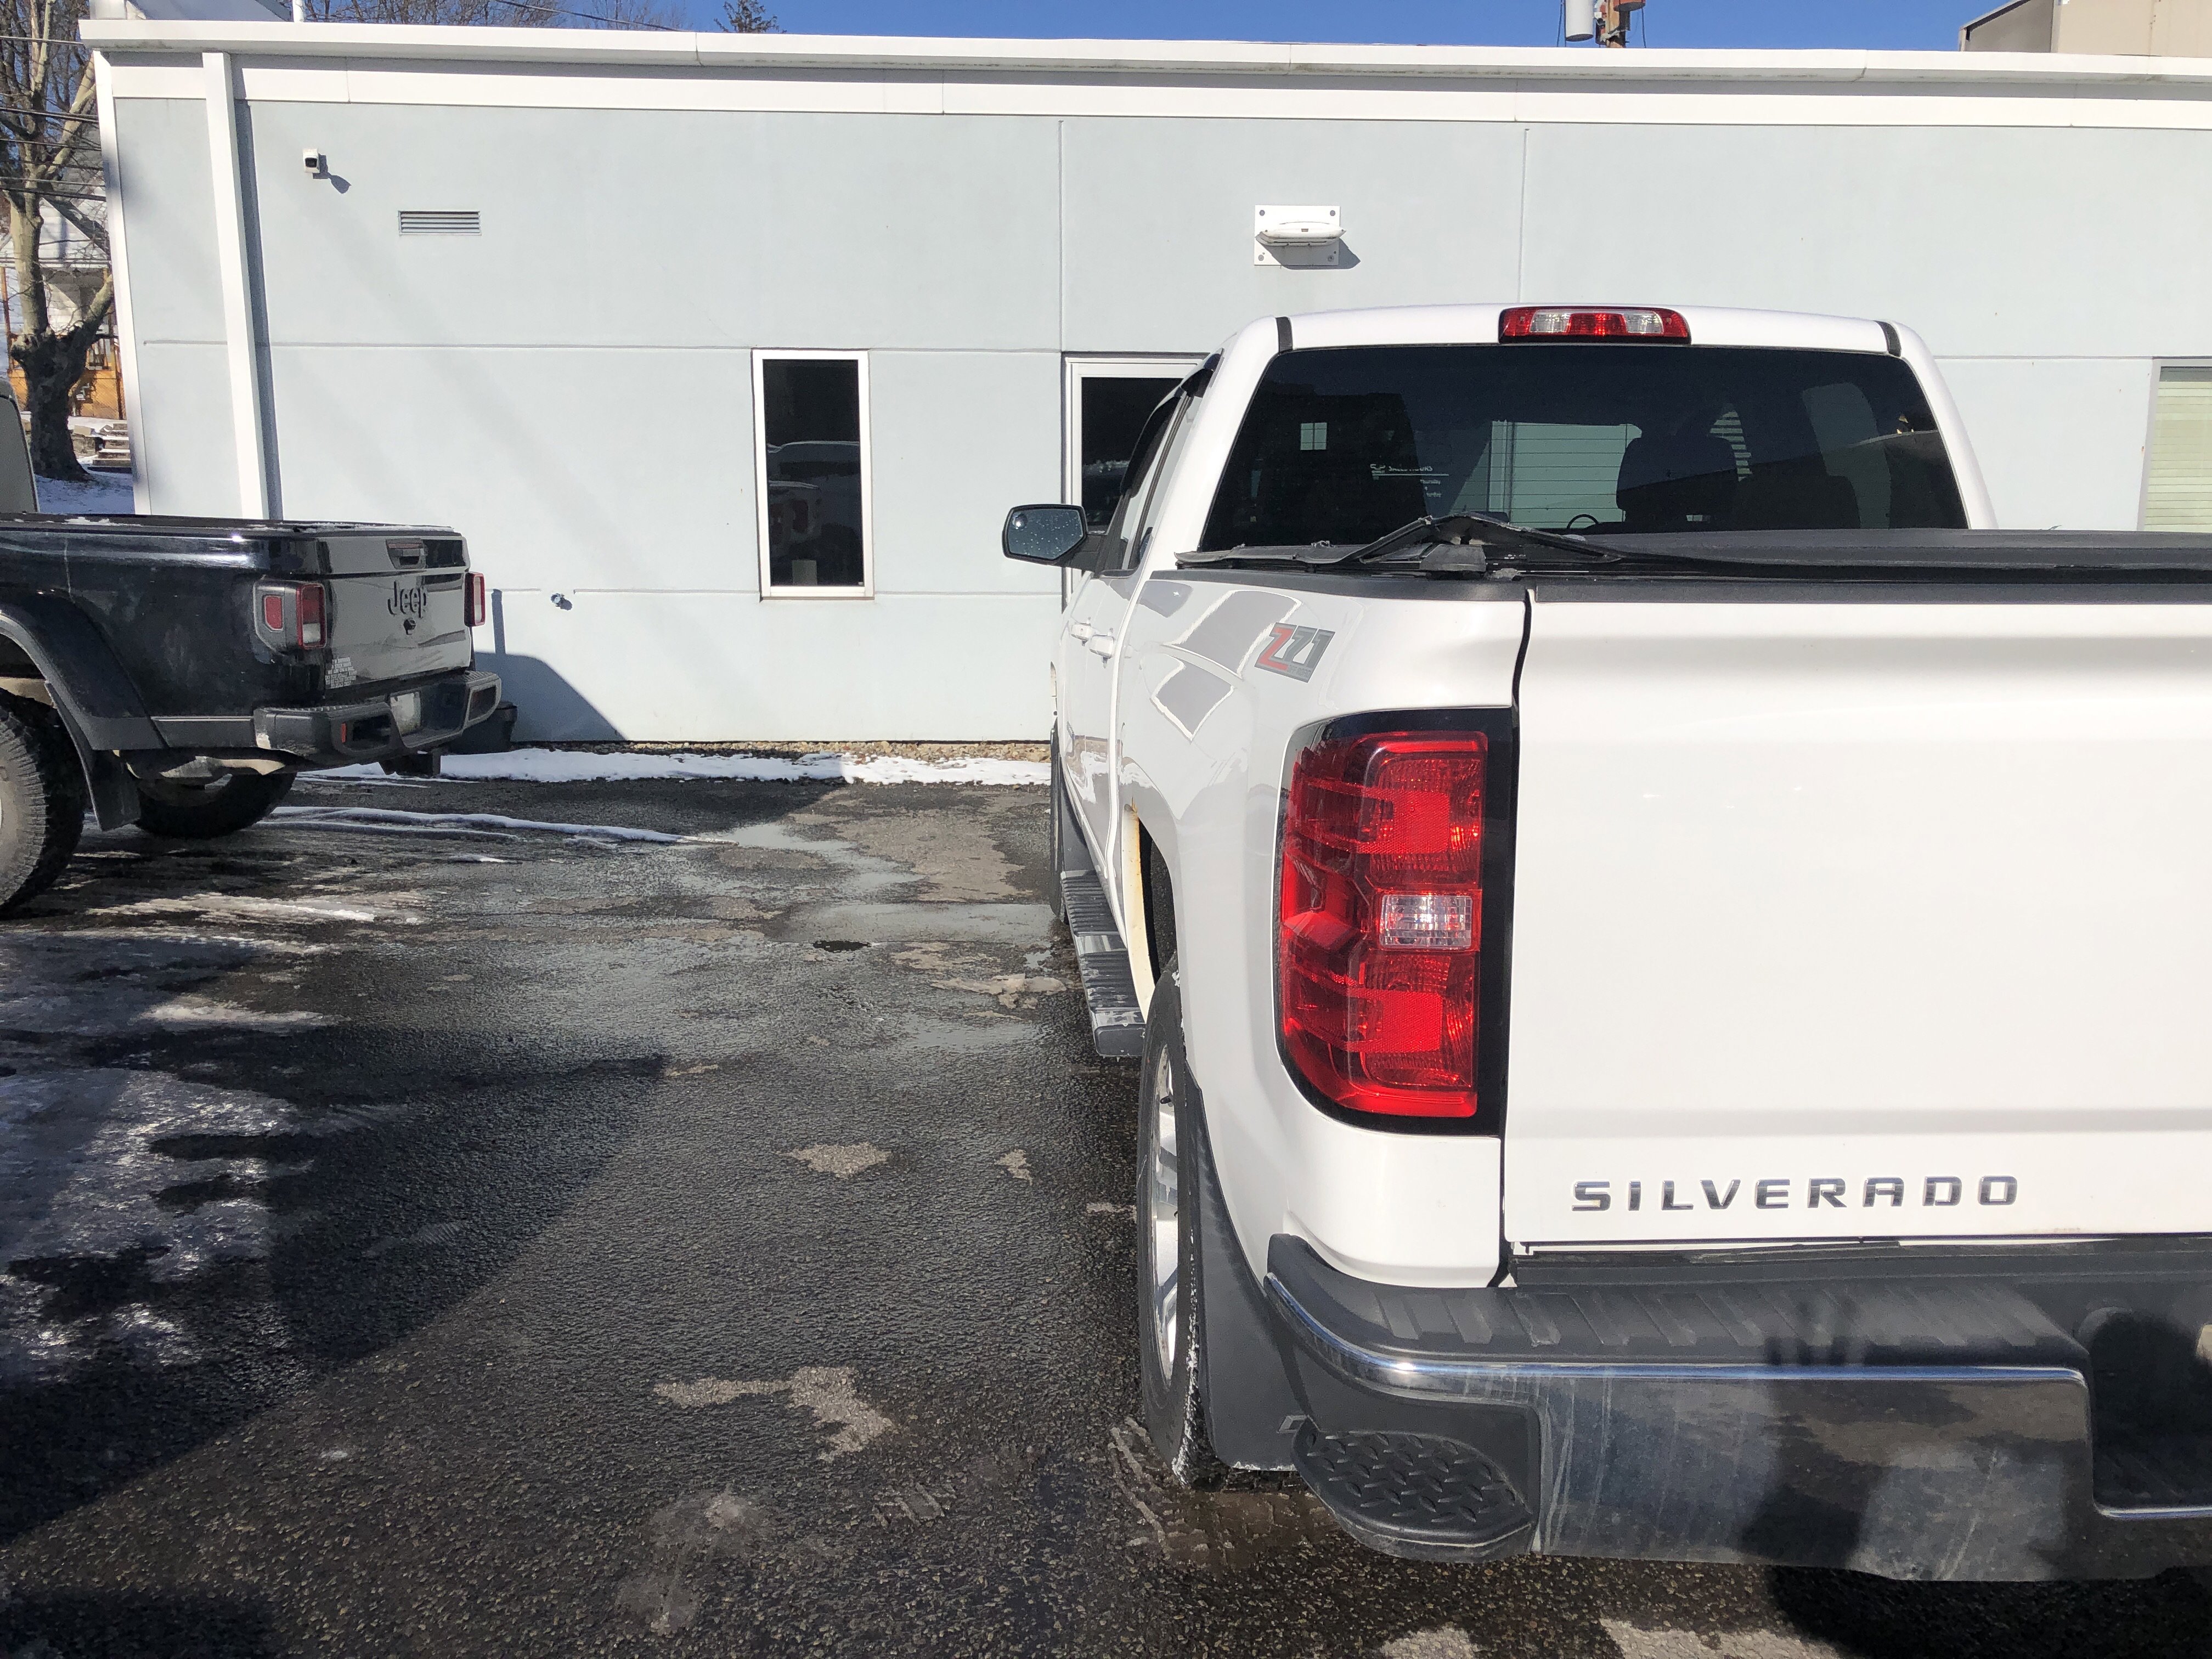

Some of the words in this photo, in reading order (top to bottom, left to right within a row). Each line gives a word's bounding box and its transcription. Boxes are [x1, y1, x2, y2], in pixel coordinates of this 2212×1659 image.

[387, 580, 427, 618] Jeep
[1255, 622, 1335, 677] Z71
[1571, 1175, 2018, 1211] SILVERADO
